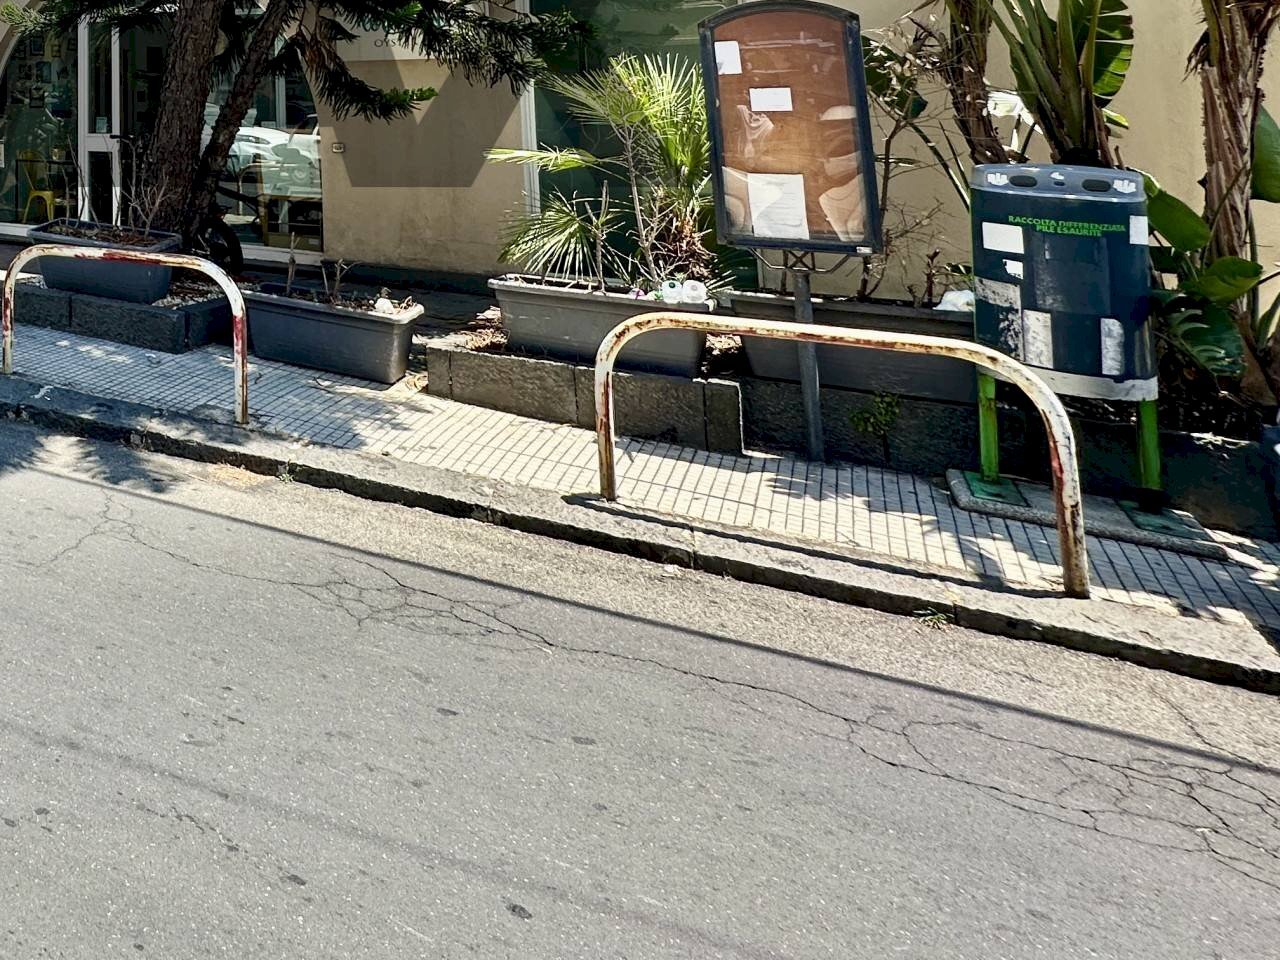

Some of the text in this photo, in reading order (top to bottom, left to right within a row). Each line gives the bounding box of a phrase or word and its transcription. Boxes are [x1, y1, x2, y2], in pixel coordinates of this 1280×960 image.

[1008, 215, 1126, 231] RACCOLTA DIFFERENZIATA
[1036, 225, 1102, 237] PILE ESAURITE
